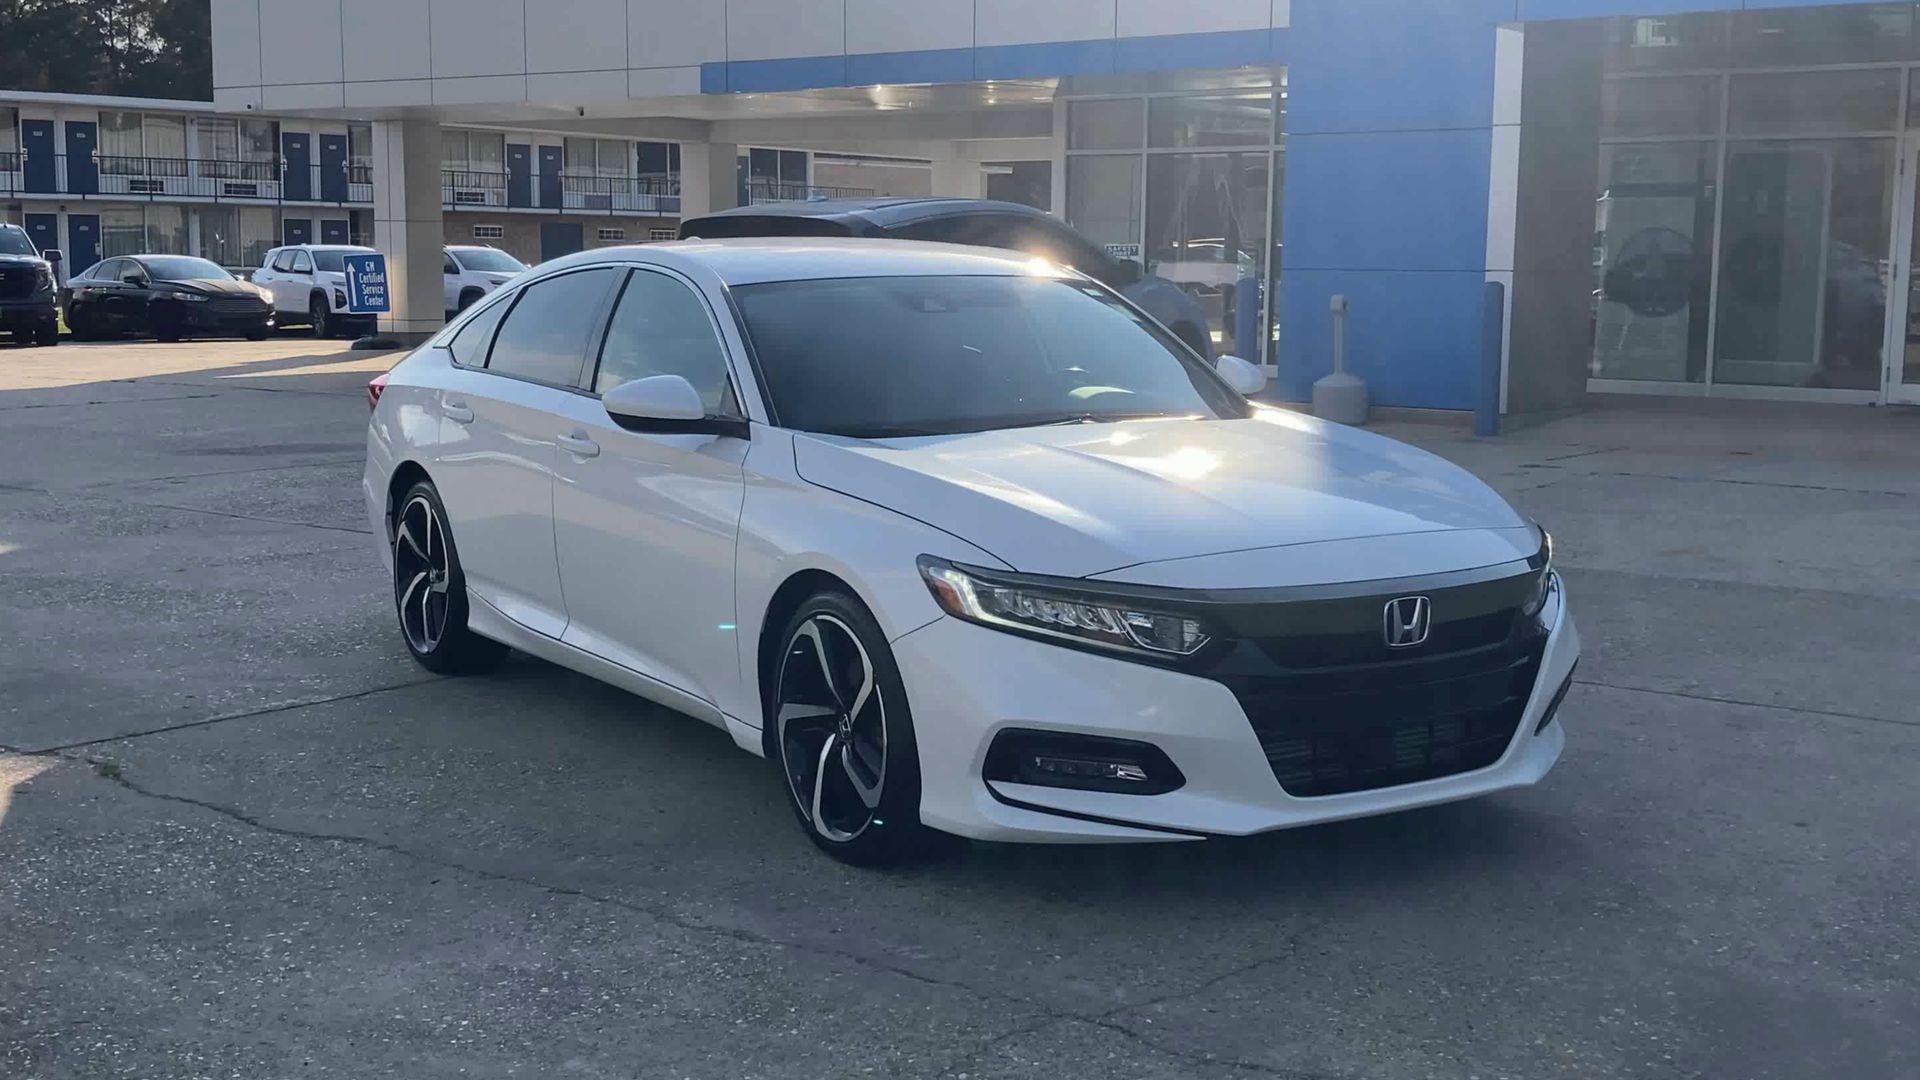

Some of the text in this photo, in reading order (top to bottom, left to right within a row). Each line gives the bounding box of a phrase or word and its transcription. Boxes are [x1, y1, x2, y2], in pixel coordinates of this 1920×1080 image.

[365, 261, 375, 272] GM
[359, 272, 384, 284] Certified
[362, 284, 384, 295] Service
[364, 295, 384, 306] Center
